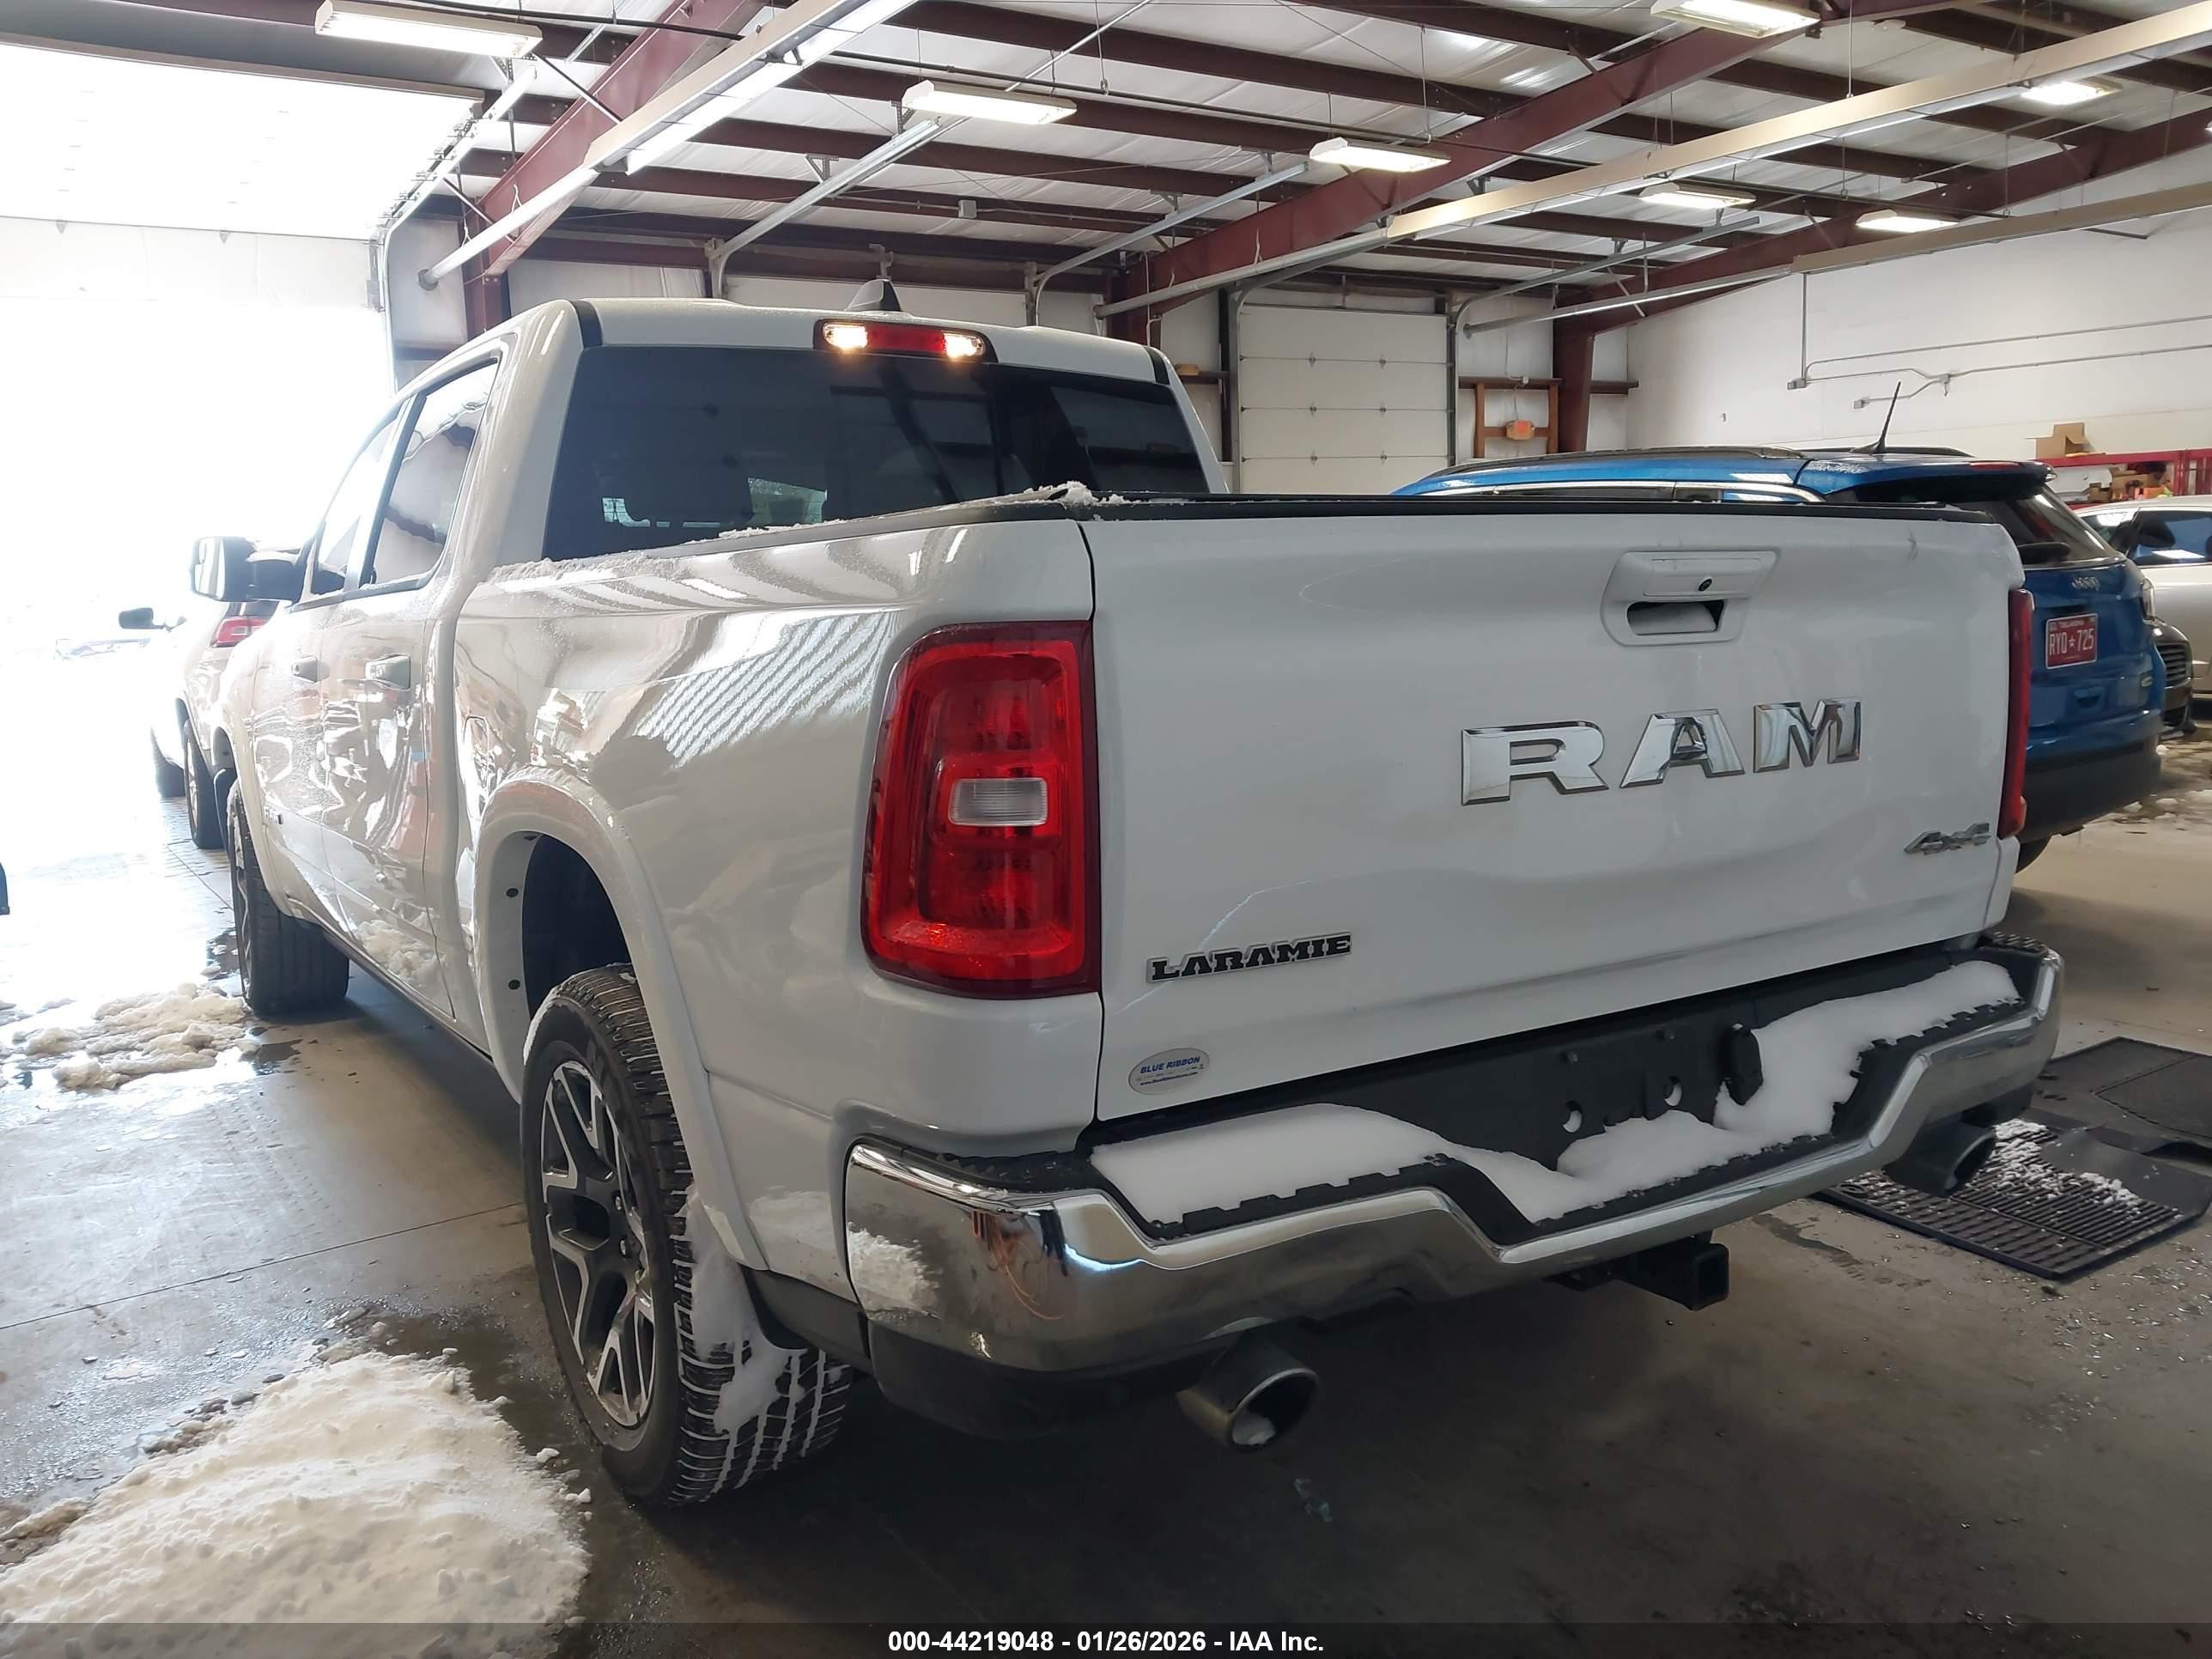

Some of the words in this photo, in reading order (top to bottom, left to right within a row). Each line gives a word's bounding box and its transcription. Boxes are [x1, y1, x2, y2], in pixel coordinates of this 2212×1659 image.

[1461, 696, 1862, 805] RAM
[1148, 932, 1352, 982] LARAMIE
[1139, 1063, 1165, 1074] BLUE
[1166, 1056, 1201, 1070] RIBBON
